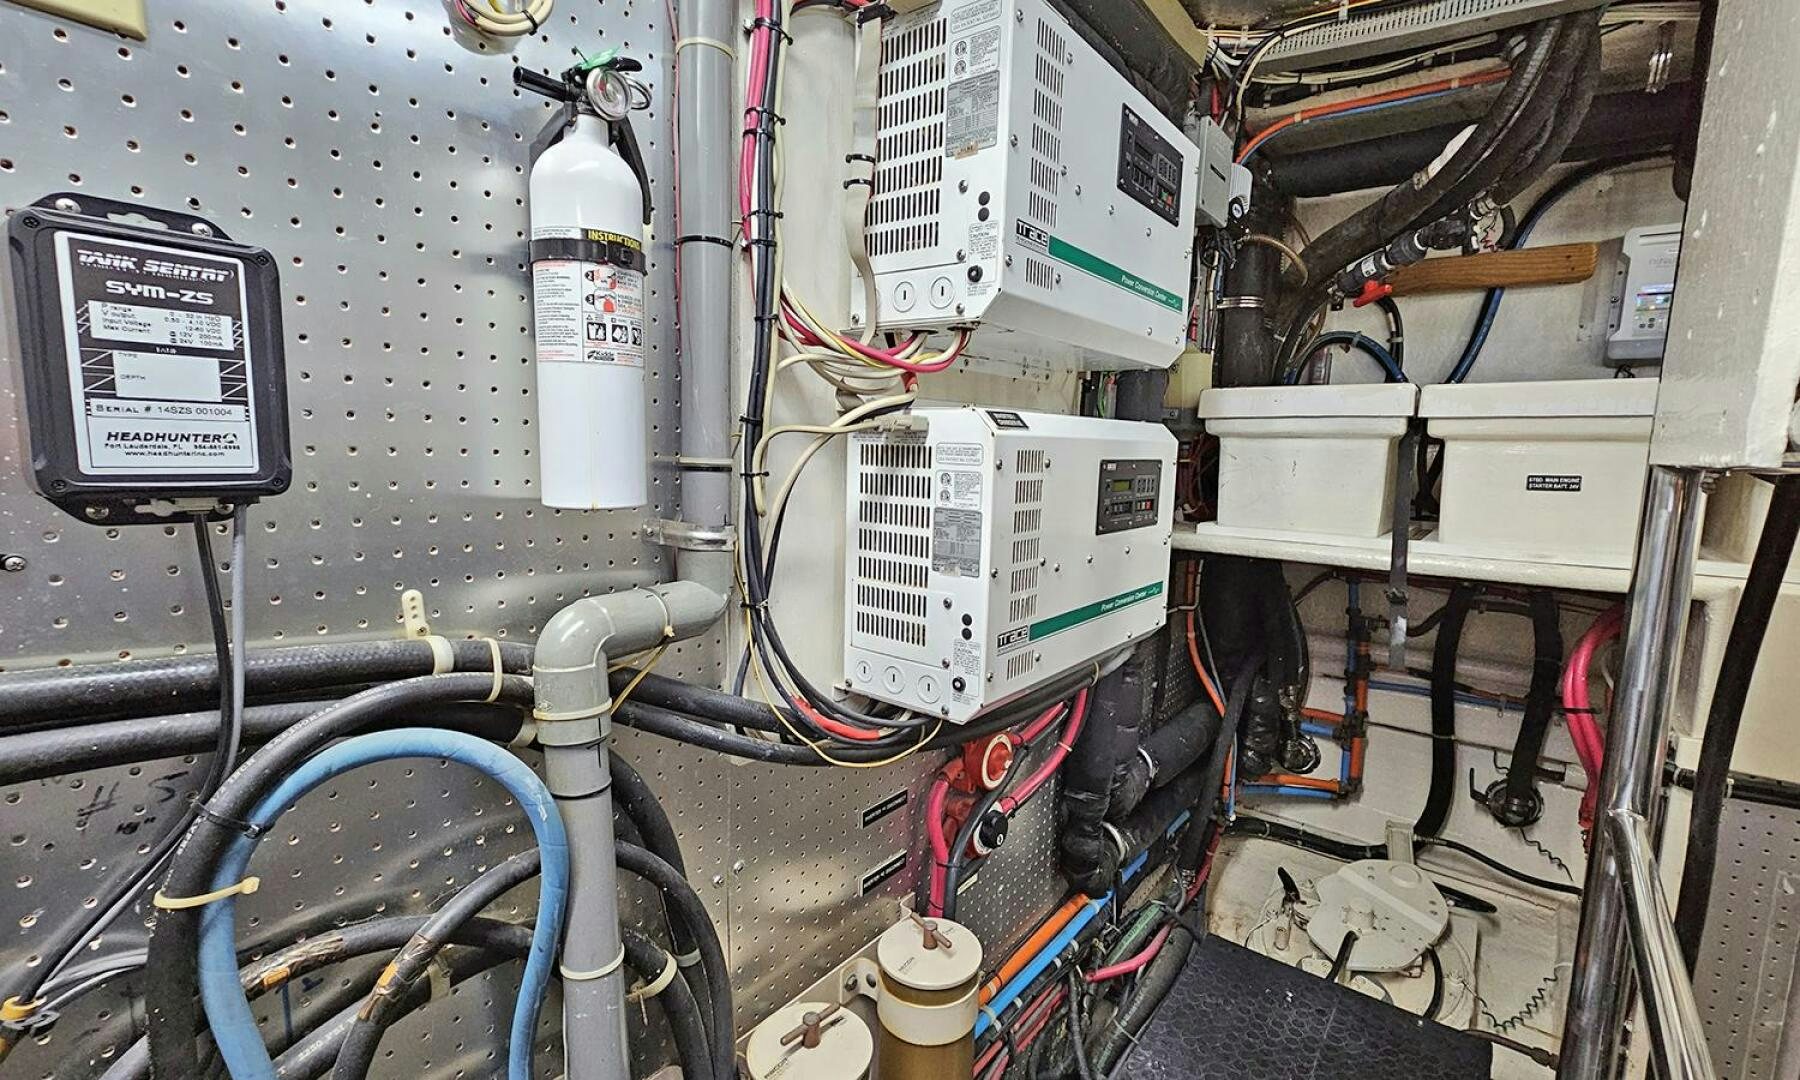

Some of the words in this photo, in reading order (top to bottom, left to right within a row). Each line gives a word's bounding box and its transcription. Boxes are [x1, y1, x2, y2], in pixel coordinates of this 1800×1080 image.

[77, 249, 138, 269] TANK
[143, 260, 230, 282] SENTRY
[105, 280, 215, 305] SYM-ZS
[124, 319, 151, 329] Voltage
[96, 405, 139, 414] SERIAL
[157, 406, 193, 415] 14SZS
[195, 407, 232, 416] 001004
[106, 431, 222, 444] HEADHUNTER
[125, 450, 225, 458] www.headhunterinc.com
